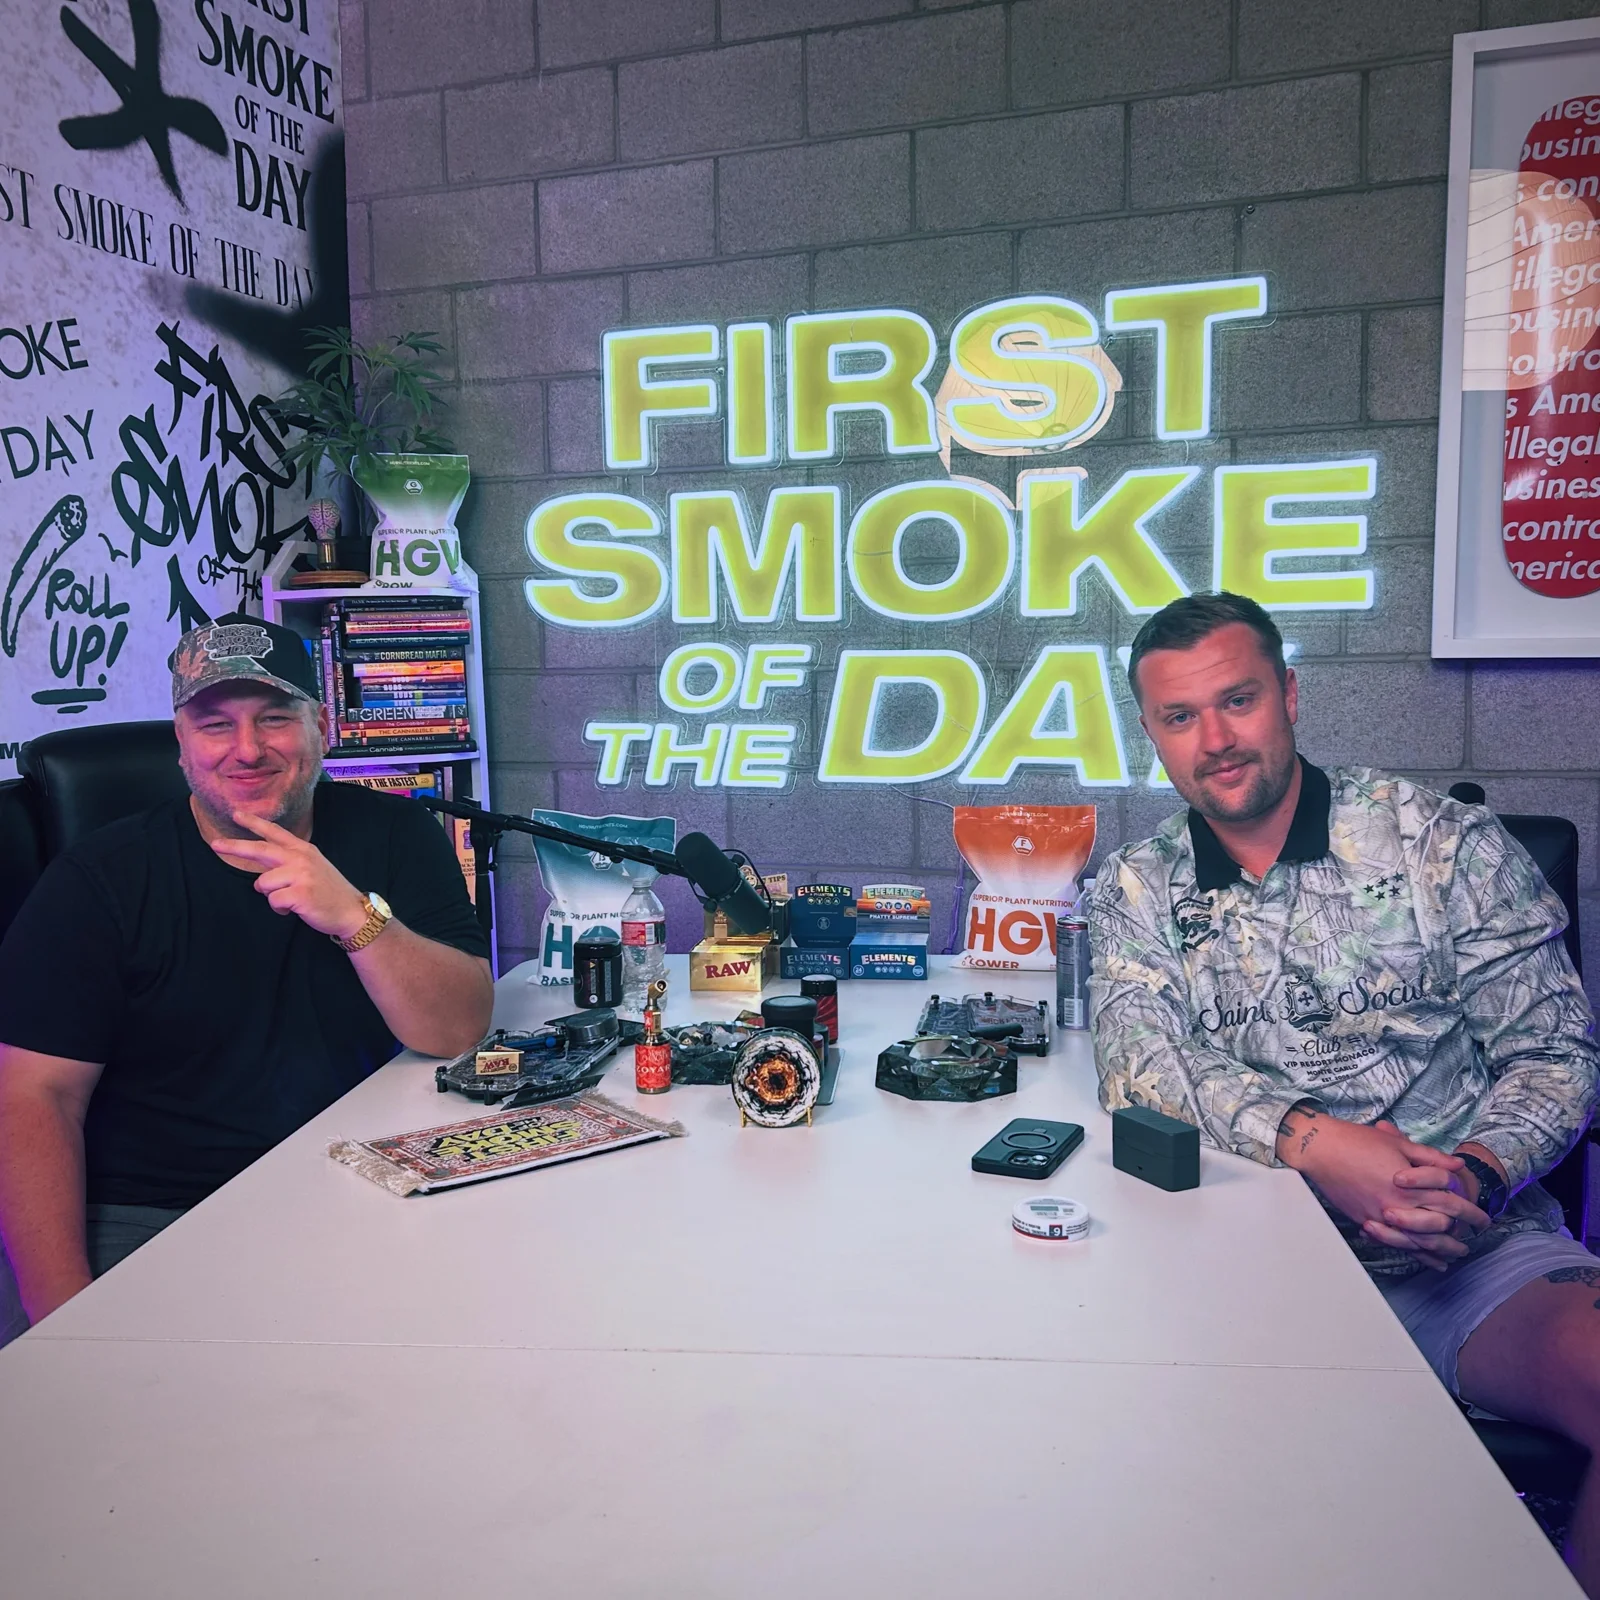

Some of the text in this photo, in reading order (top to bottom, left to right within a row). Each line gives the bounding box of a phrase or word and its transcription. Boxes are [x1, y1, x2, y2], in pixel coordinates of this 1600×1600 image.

[194, 0, 335, 124] SMOKE
[234, 95, 305, 155] OF THE
[232, 138, 312, 232] DAY
[54, 183, 156, 267] SMOKE
[169, 223, 201, 280] OF
[214, 237, 264, 300] THE
[273, 257, 318, 312] DAY
[602, 276, 1267, 469] FIRST
[0, 409, 94, 480] DAY
[522, 457, 1378, 628] SMOKE
[197, 554, 231, 588] OF
[50, 620, 128, 687] UP!
[380, 651, 424, 660] CORNBREAD
[425, 650, 448, 659] MAFIA
[327, 675, 335, 704] MICROBES
[659, 642, 811, 714] OF
[360, 707, 415, 721] GREEN
[329, 720, 337, 745] TEAMING
[369, 745, 404, 753] Cannabis
[585, 722, 797, 788] THE
[364, 778, 373, 788] OF
[373, 777, 389, 788] THE
[388, 776, 418, 787] FASTEST
[769, 874, 786, 883] TIPS
[797, 885, 851, 897] ELEMENTS
[866, 887, 922, 899] ELEMENTS
[973, 894, 1004, 903] SUPERIOR
[1005, 897, 1031, 905] PLANT
[581, 912, 607, 921] PLANT
[705, 960, 752, 979] RAW
[787, 954, 842, 965] ELEMENTS
[861, 953, 916, 966] ELEMENTS
[1300, 1058, 1332, 1068] RESORT
[1334, 1047, 1376, 1064] MONACO
[1306, 1064, 1359, 1076] MONTE CARLO
[433, 1120, 582, 1157] SMOKE
[435, 1123, 513, 1149] DAY
[466, 1127, 581, 1162] FIRST
